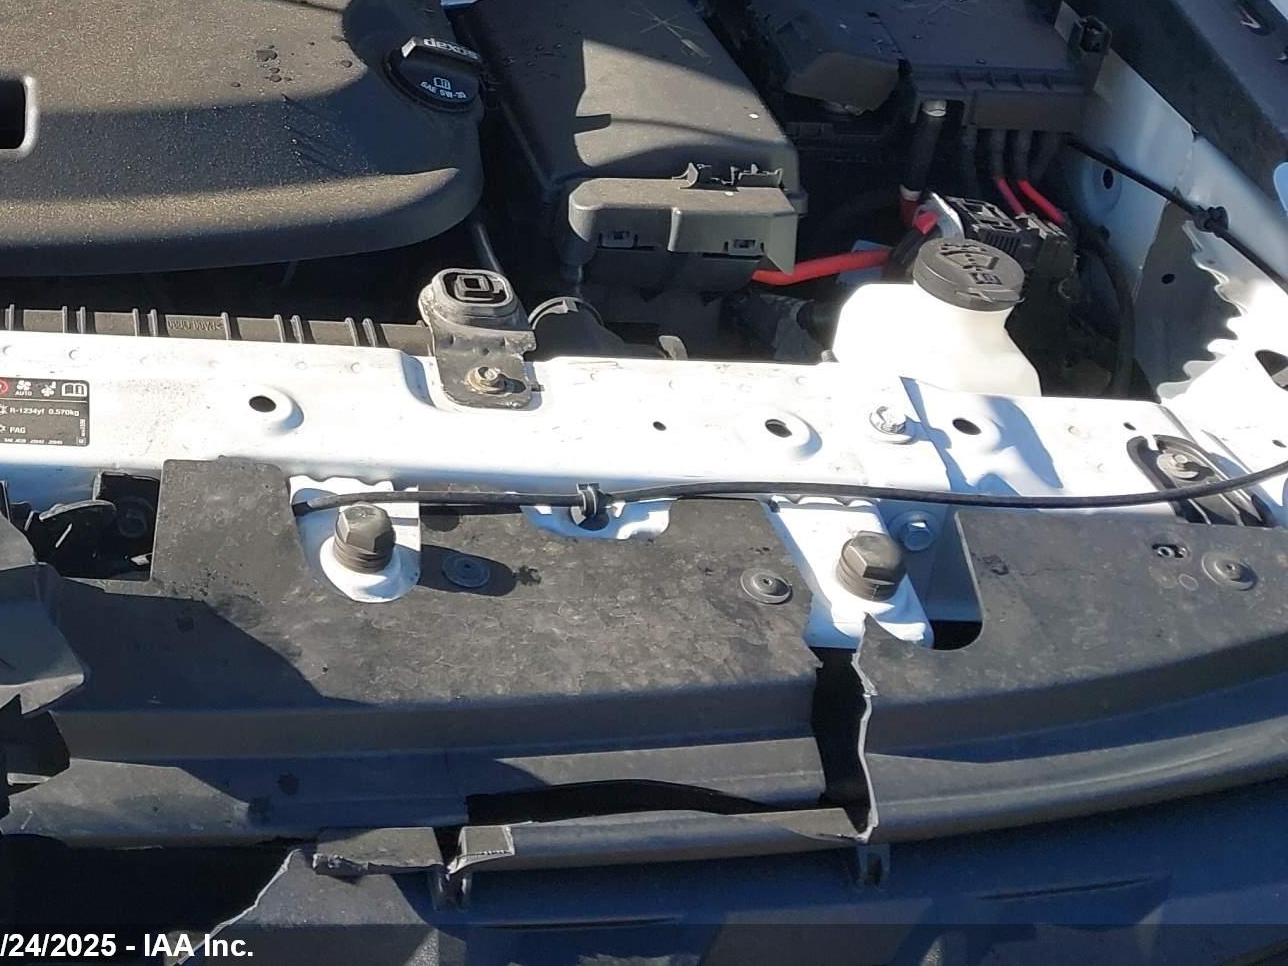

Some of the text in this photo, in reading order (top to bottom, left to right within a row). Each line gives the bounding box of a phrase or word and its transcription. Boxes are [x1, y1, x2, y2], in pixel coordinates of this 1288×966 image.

[423, 37, 480, 60] dexos
[9, 407, 45, 416] R-1234yf
[9, 426, 26, 434] PAG
